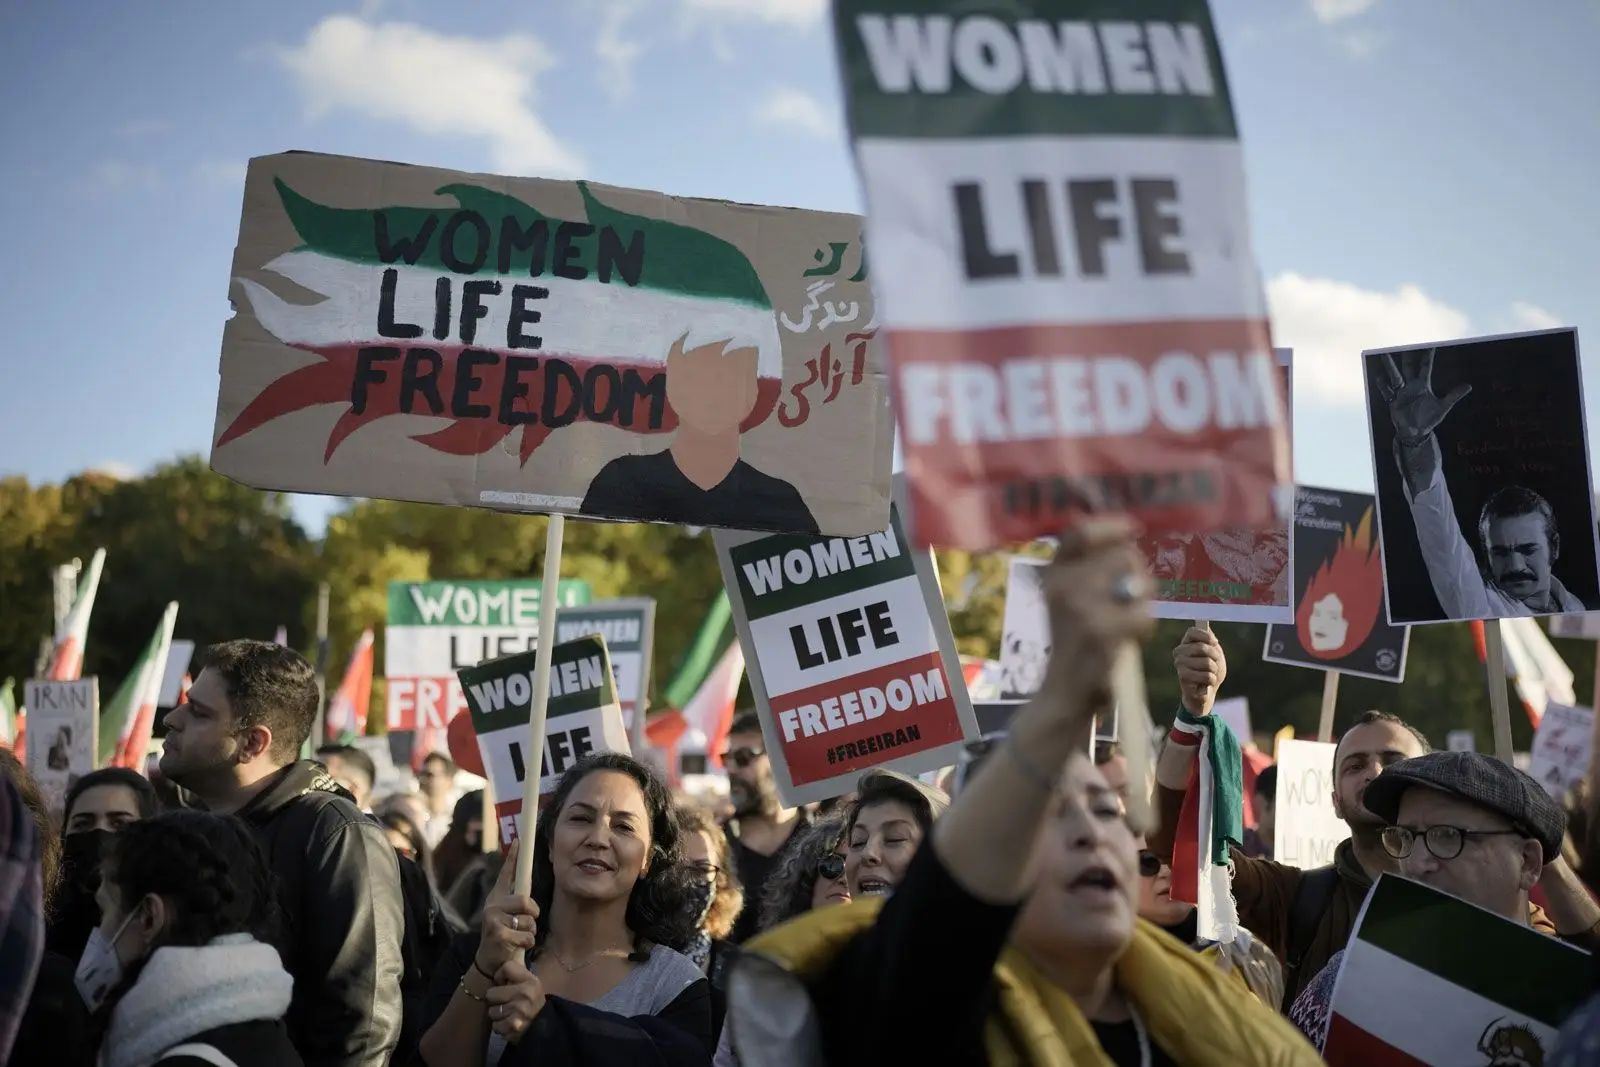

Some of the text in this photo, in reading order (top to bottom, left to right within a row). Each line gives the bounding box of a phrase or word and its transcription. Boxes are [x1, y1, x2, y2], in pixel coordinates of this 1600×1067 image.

[856, 14, 1216, 96] WOMEN
[372, 209, 646, 286] WOMEN
[951, 177, 1194, 280] LIFE
[376, 268, 550, 350] LIFE
[351, 346, 668, 430] FREEDOM
[900, 350, 1279, 446] FREEDOM
[742, 523, 901, 597] WOMEN
[788, 600, 900, 671] LIFE
[33, 684, 87, 710] IRAN
[779, 668, 948, 743] FREEDOM
[826, 724, 921, 765] #FREEIRAN
[1283, 767, 1333, 807] WOM
